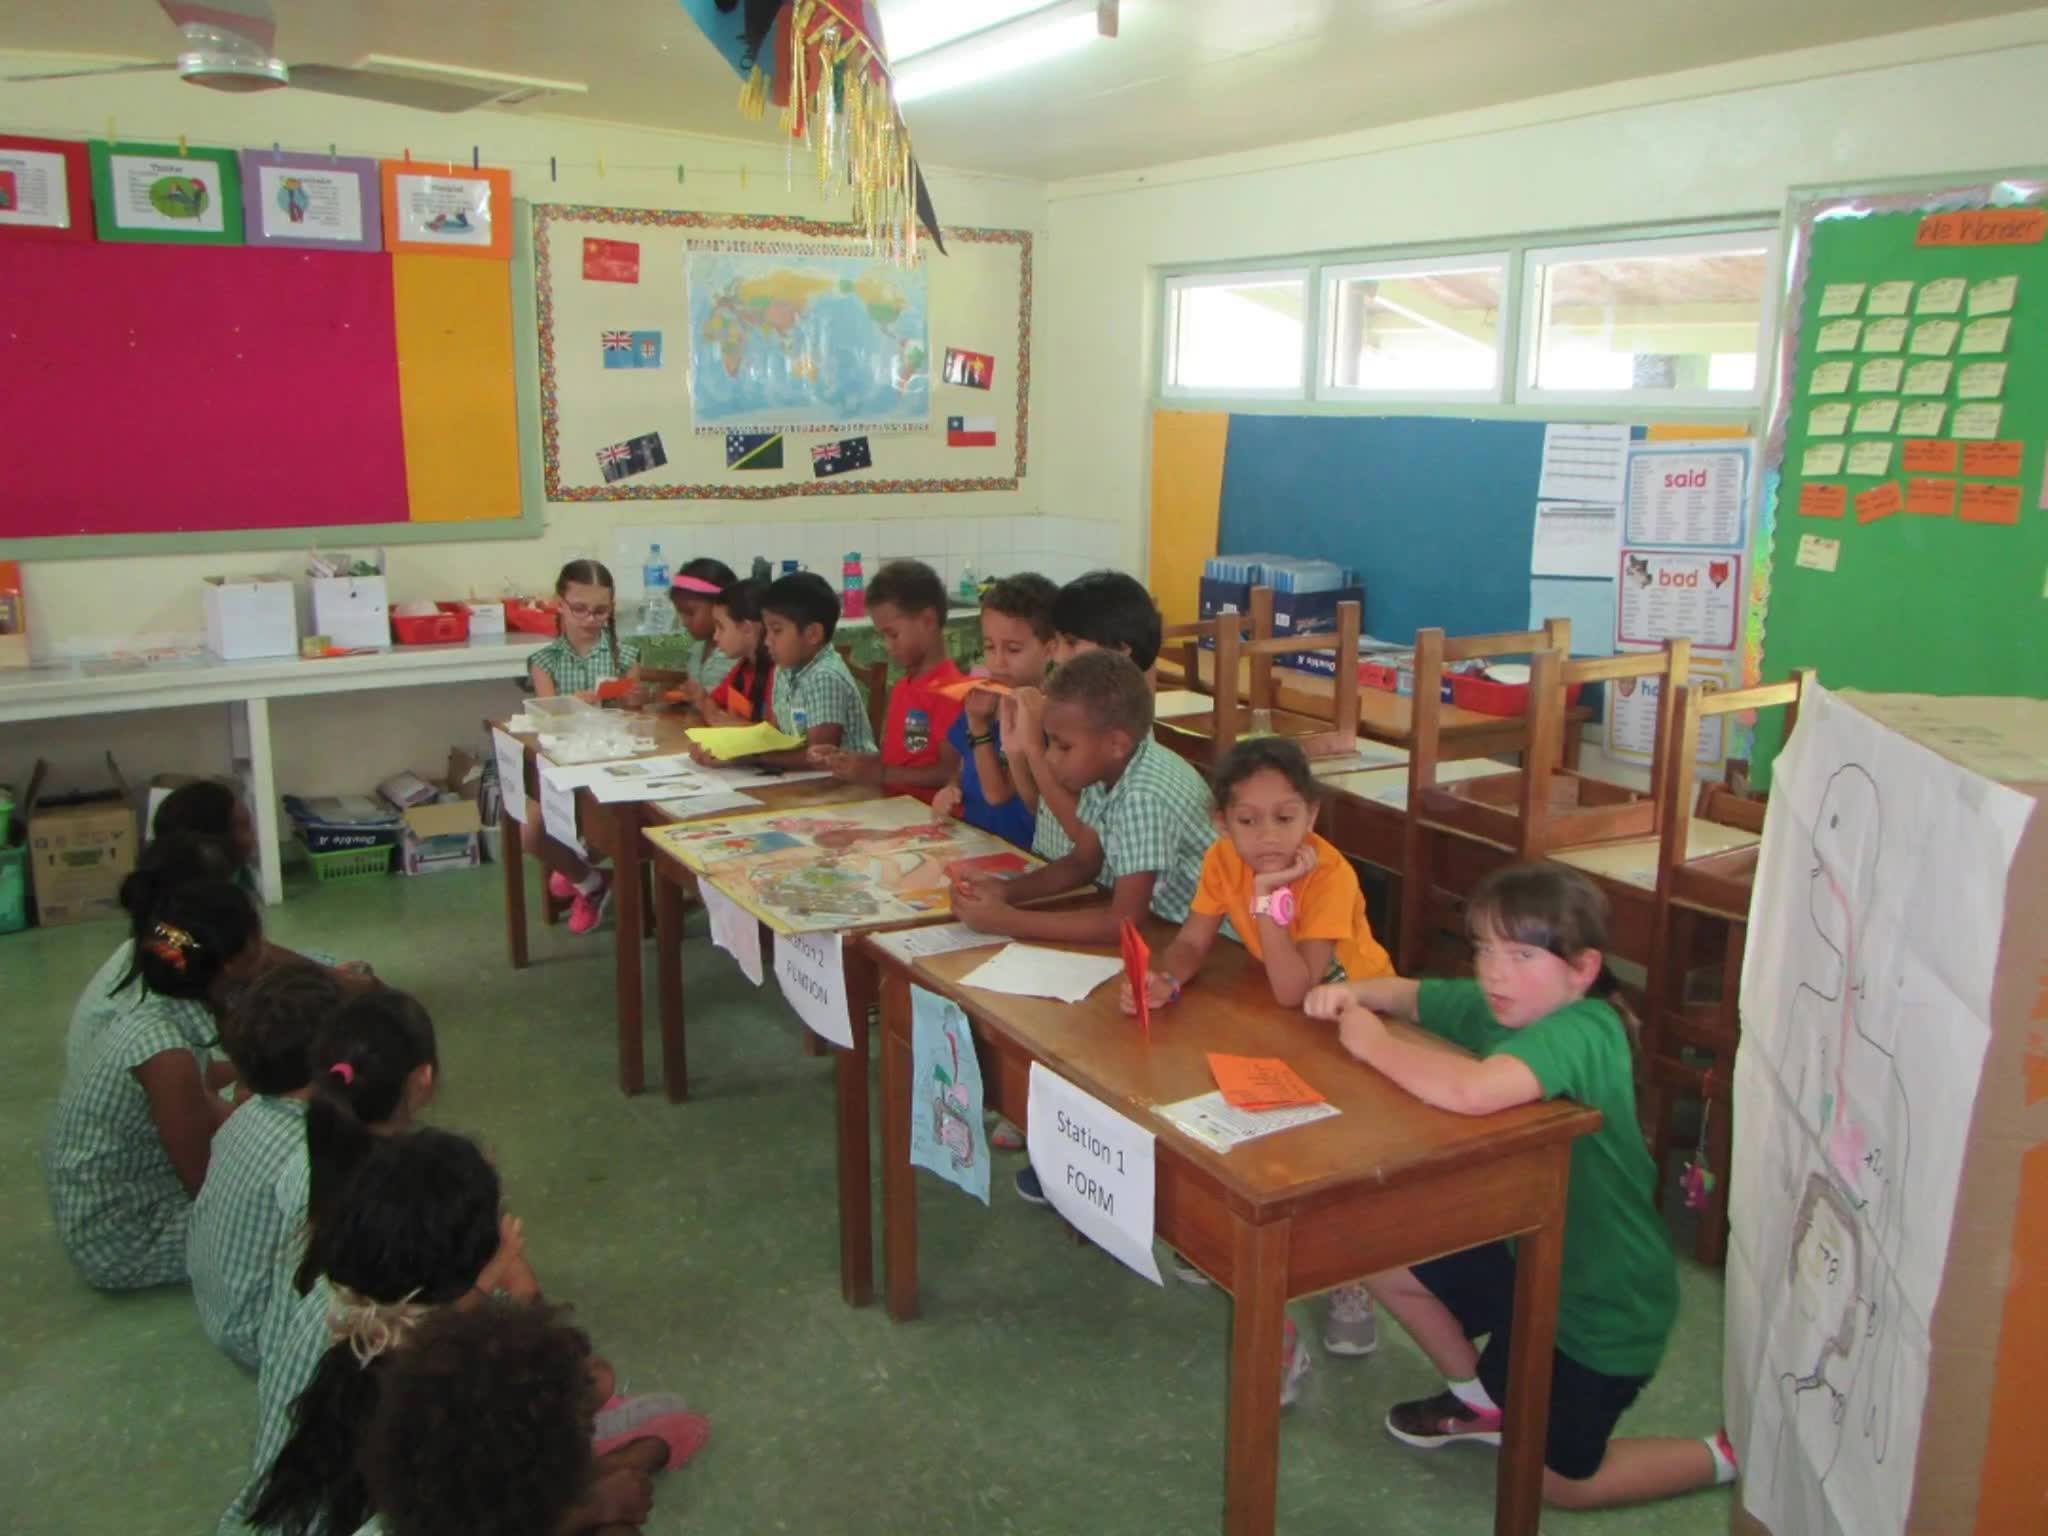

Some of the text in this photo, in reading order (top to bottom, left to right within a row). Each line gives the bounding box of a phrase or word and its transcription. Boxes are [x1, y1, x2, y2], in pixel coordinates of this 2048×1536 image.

[1663, 468, 1708, 489] said
[1658, 567, 1699, 588] bad
[1057, 1110, 1126, 1176] Station 1
[1066, 1164, 1114, 1216] FORM
